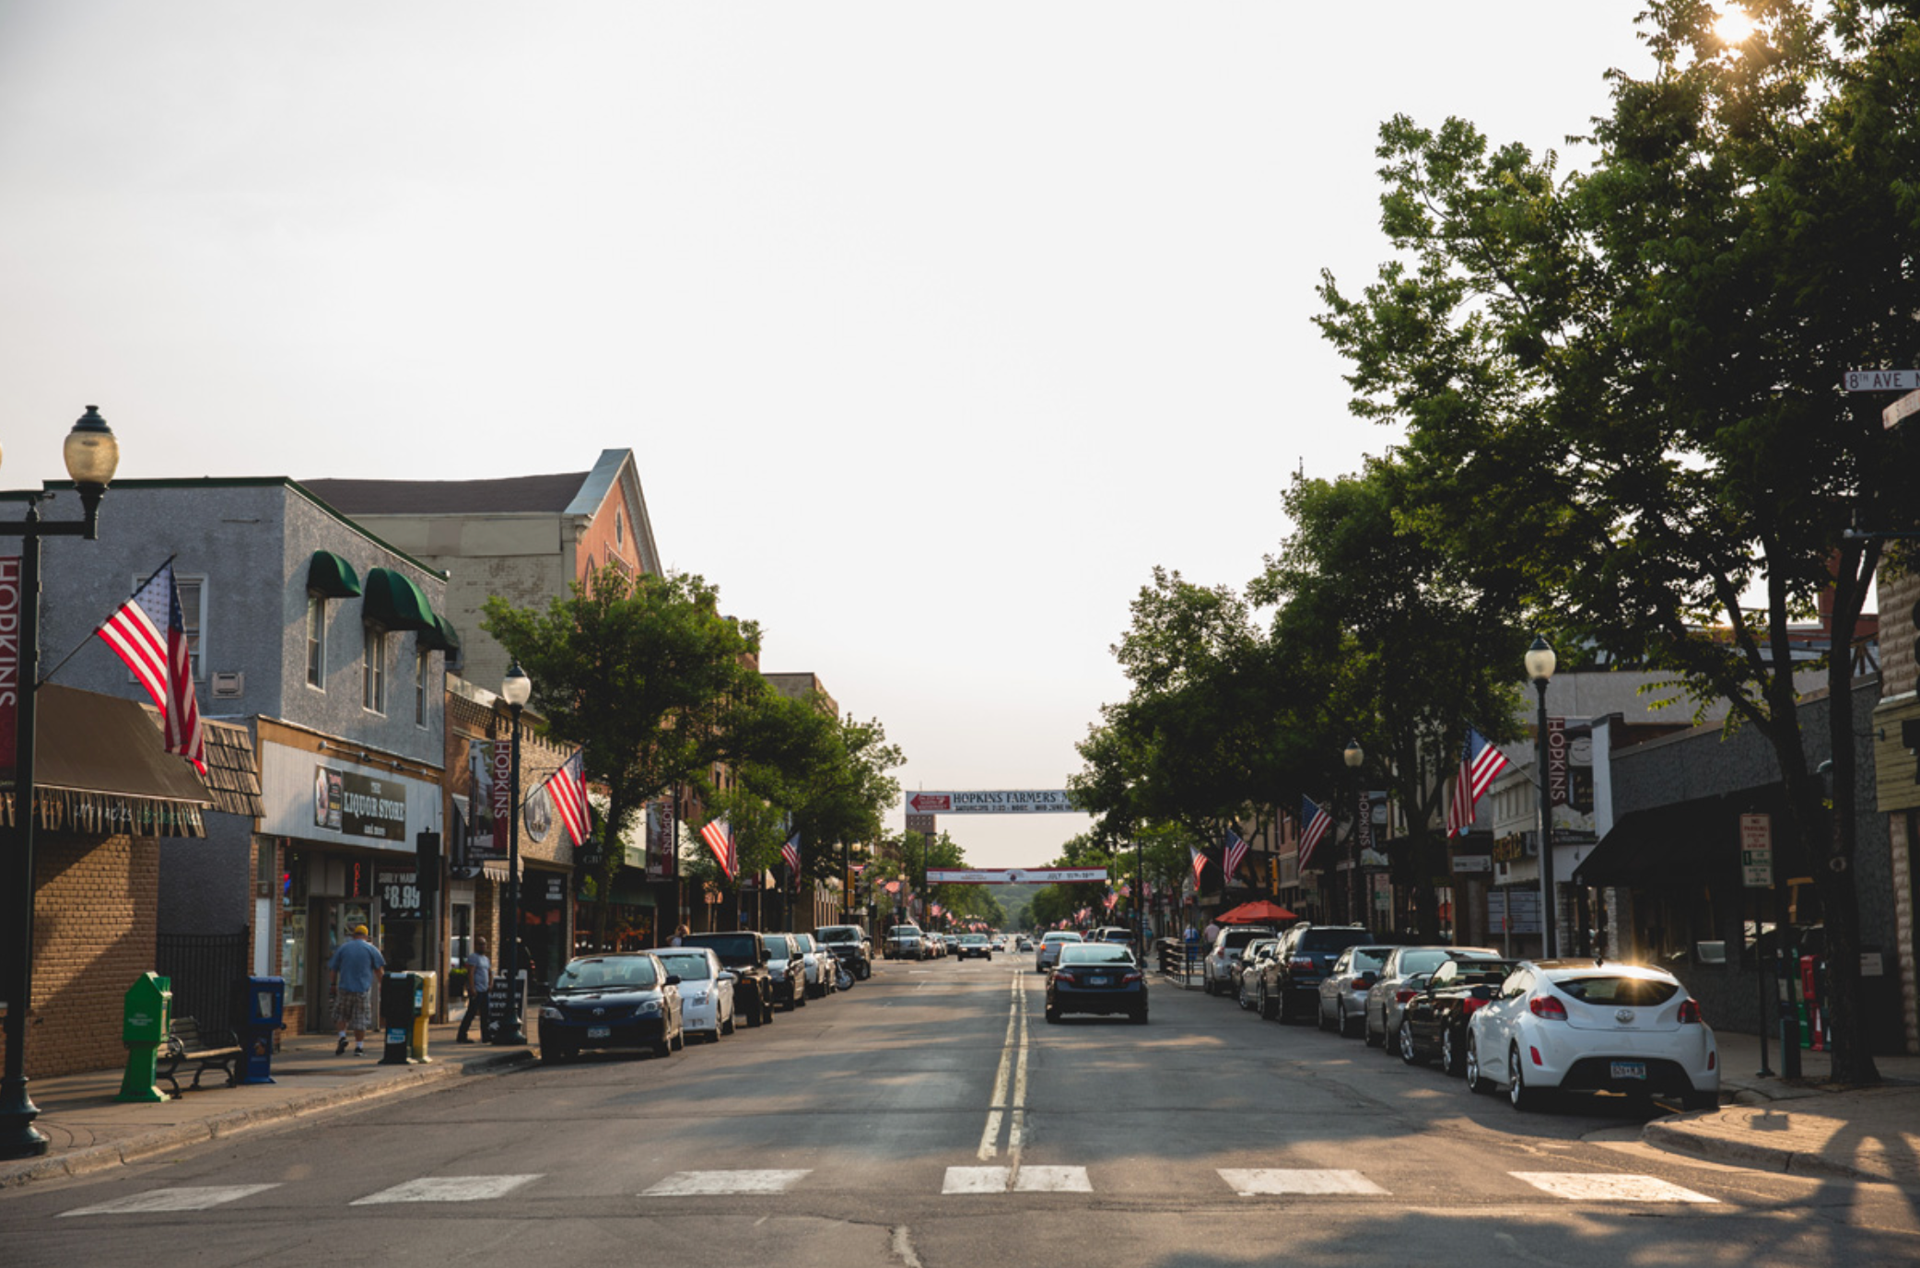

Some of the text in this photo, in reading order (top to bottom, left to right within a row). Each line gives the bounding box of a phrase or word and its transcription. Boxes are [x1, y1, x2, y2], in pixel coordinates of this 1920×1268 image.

[1850, 373, 1869, 389] 8TH
[1873, 372, 1903, 388] AVE
[1550, 720, 1566, 800] HOPKINS
[495, 742, 510, 819] HOPKINS
[953, 792, 1003, 803] HOPKINS
[344, 792, 378, 818] LIQUOR
[379, 798, 405, 821] STORE
[663, 803, 672, 855] HOPKINS
